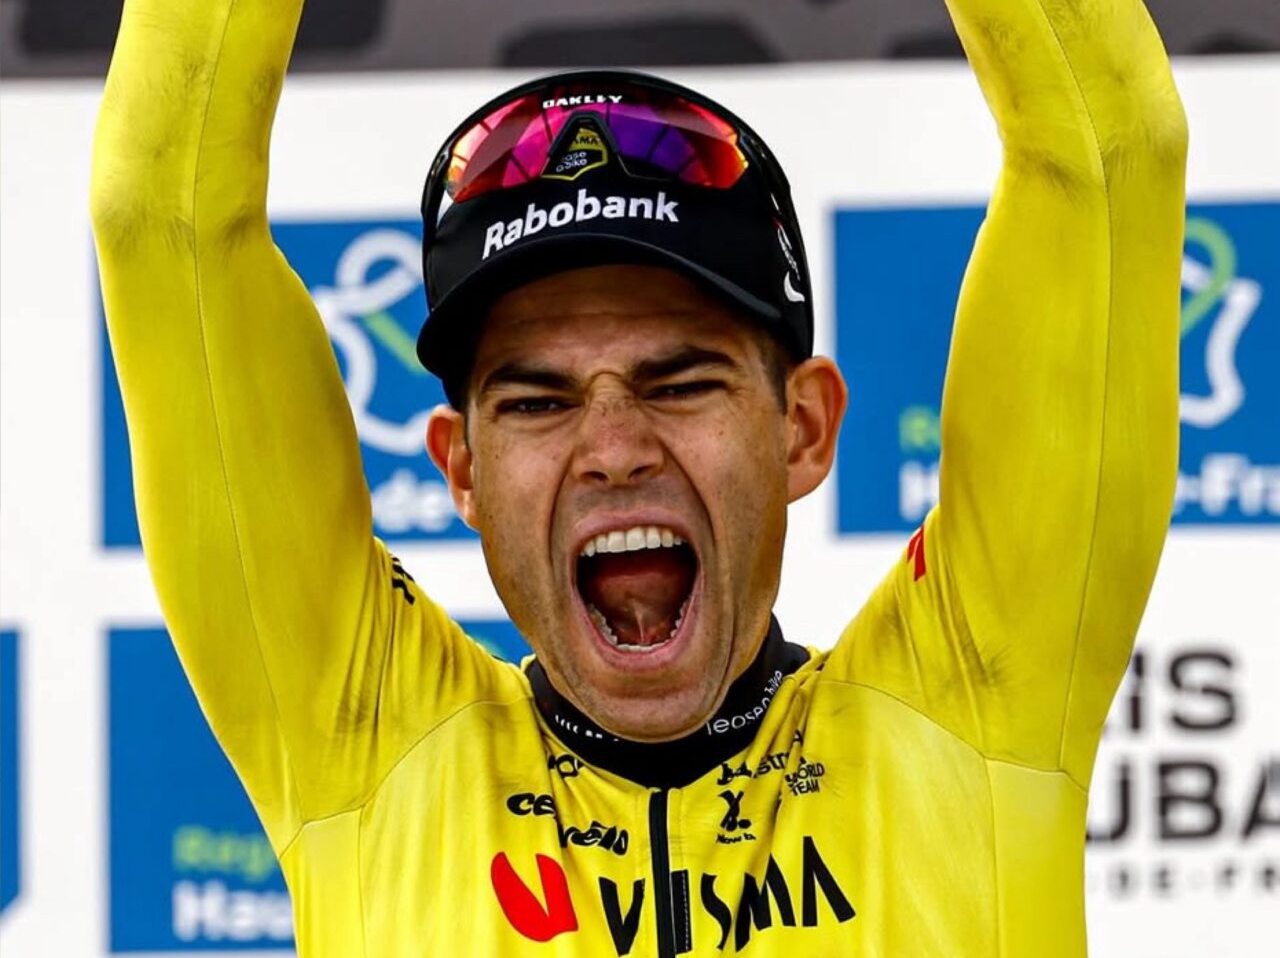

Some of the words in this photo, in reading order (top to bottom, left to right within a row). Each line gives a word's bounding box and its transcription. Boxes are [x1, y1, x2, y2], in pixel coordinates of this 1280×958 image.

[542, 94, 623, 110] OAKLEY
[481, 189, 680, 260] Rabobank
[598, 835, 857, 958] VISMA
